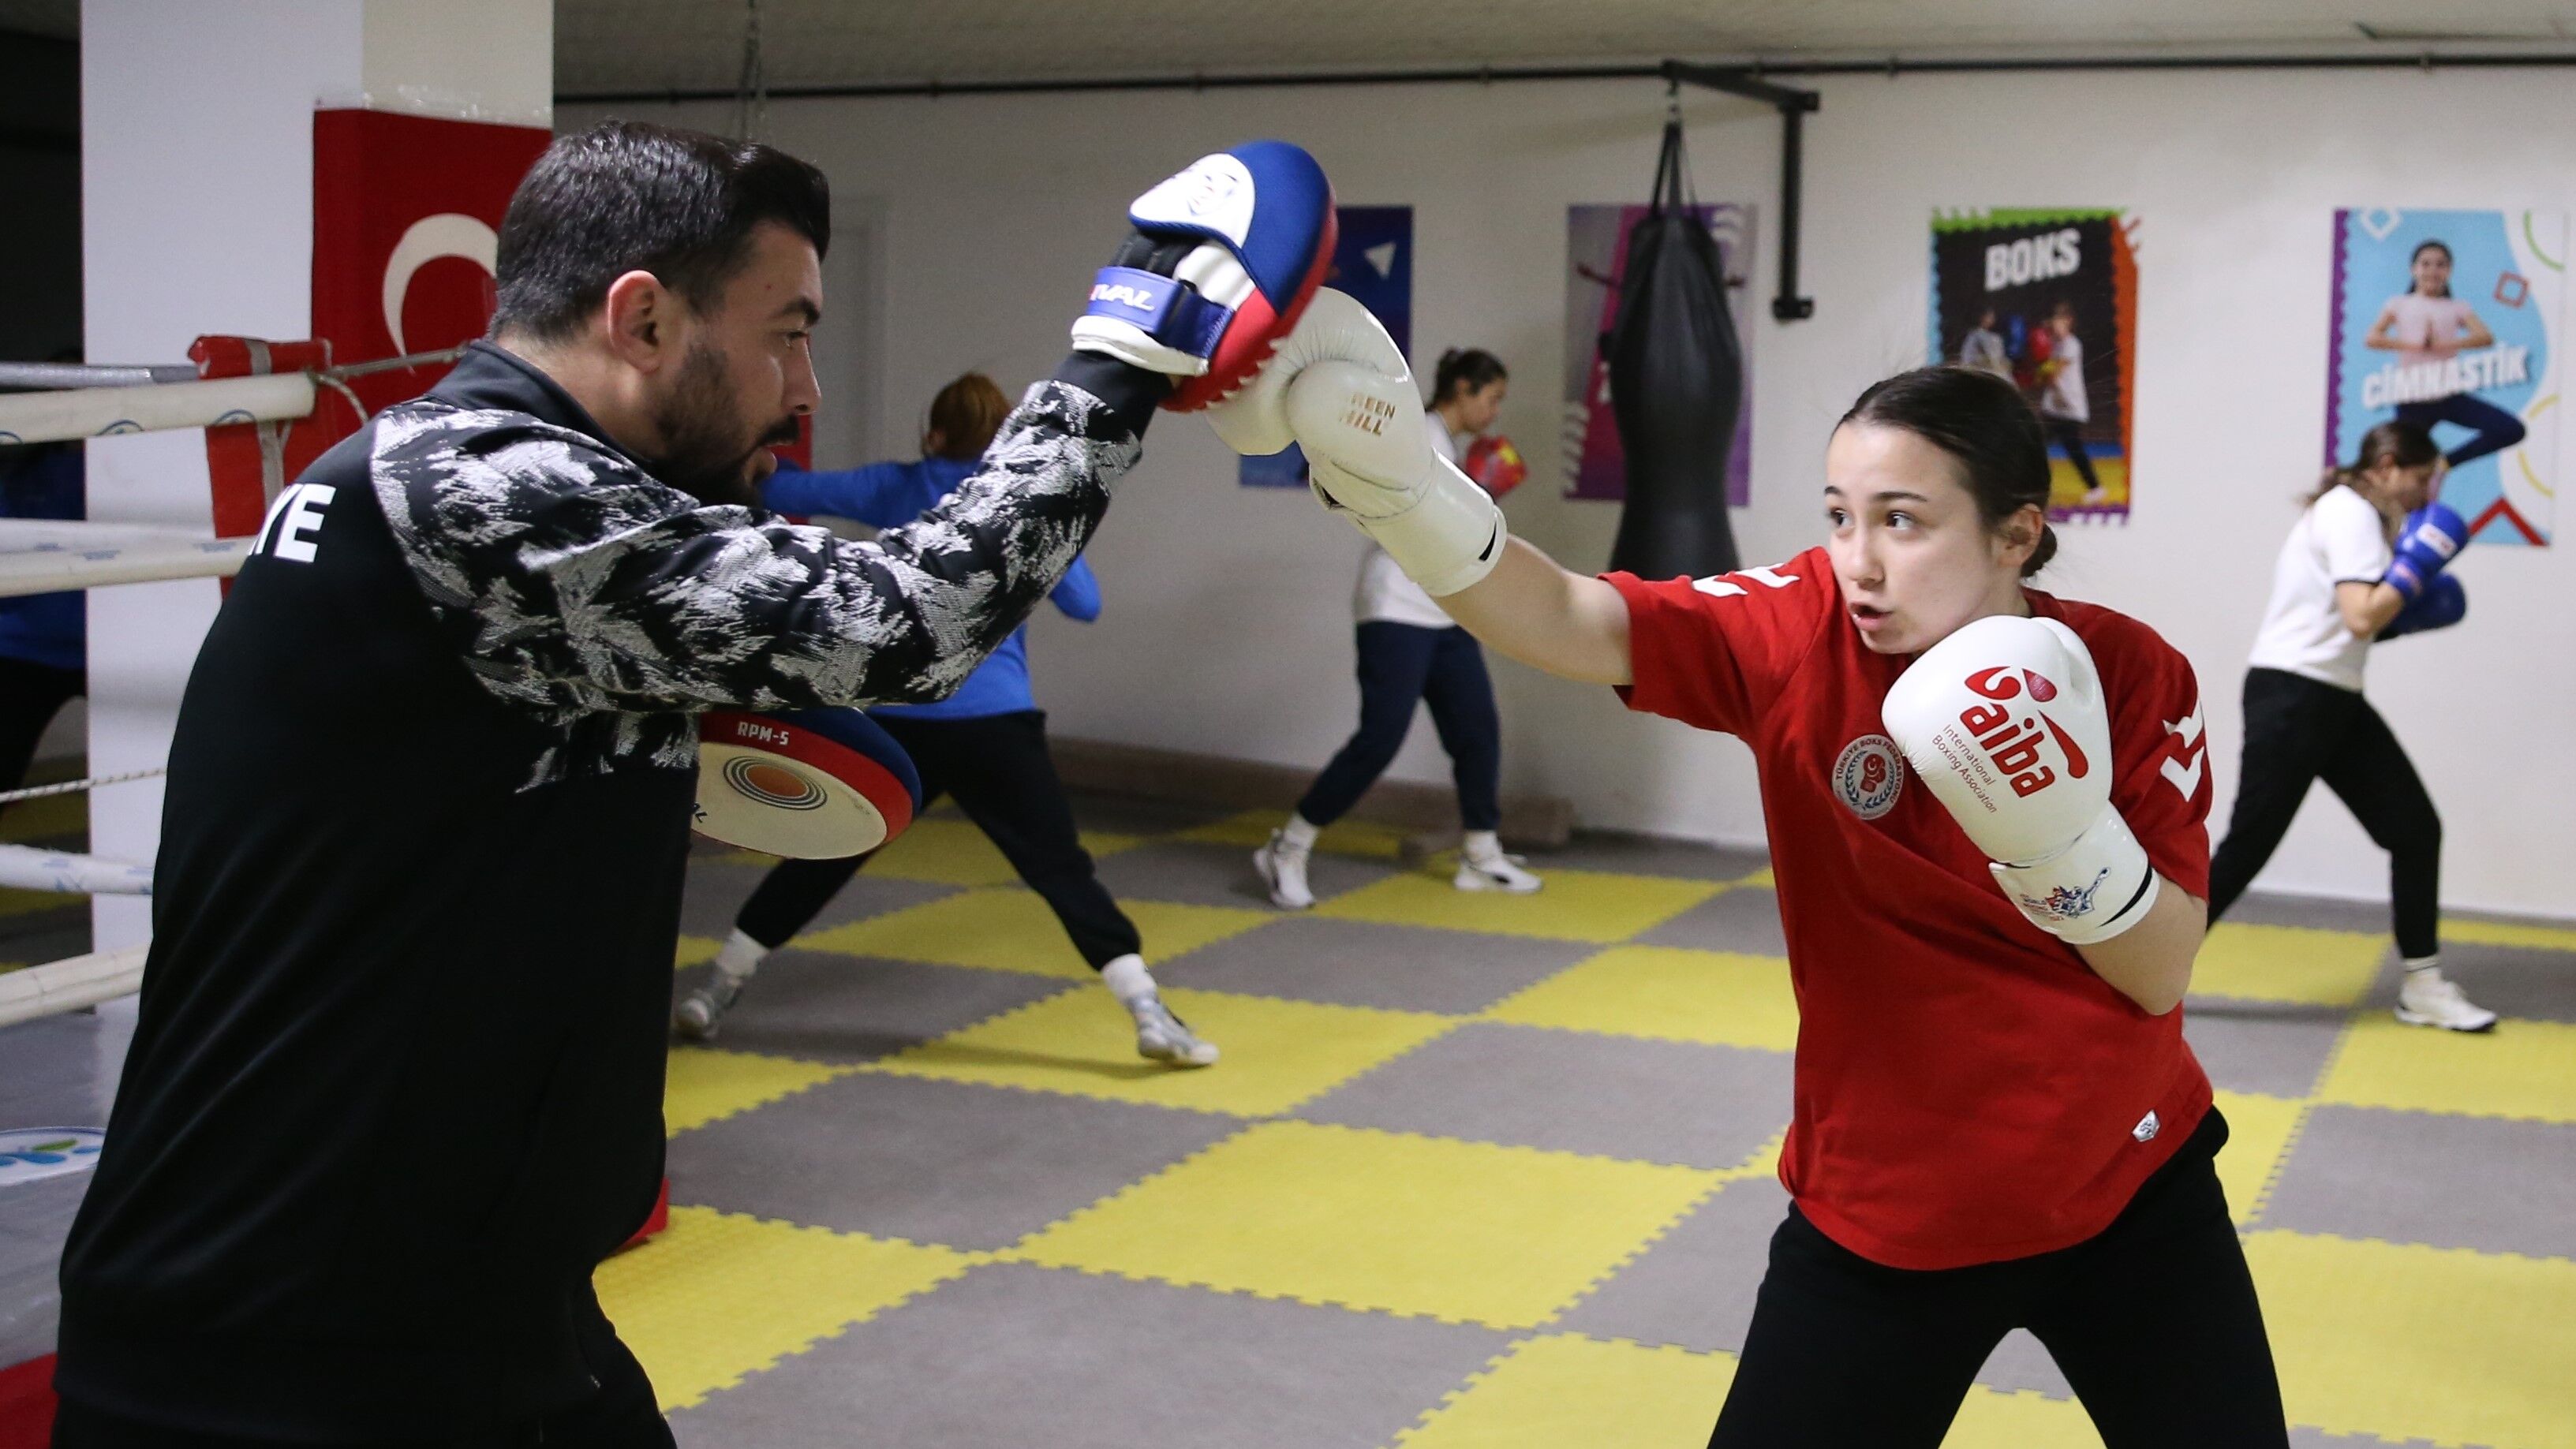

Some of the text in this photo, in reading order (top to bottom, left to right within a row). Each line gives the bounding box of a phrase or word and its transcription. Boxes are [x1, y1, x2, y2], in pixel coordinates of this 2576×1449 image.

[1983, 227, 2082, 293] BOKS
[1088, 283, 1156, 312] IVAL
[1931, 734, 1998, 814] Boxing Association
[1942, 723, 1997, 786] International
[1959, 701, 2056, 798] aiba
